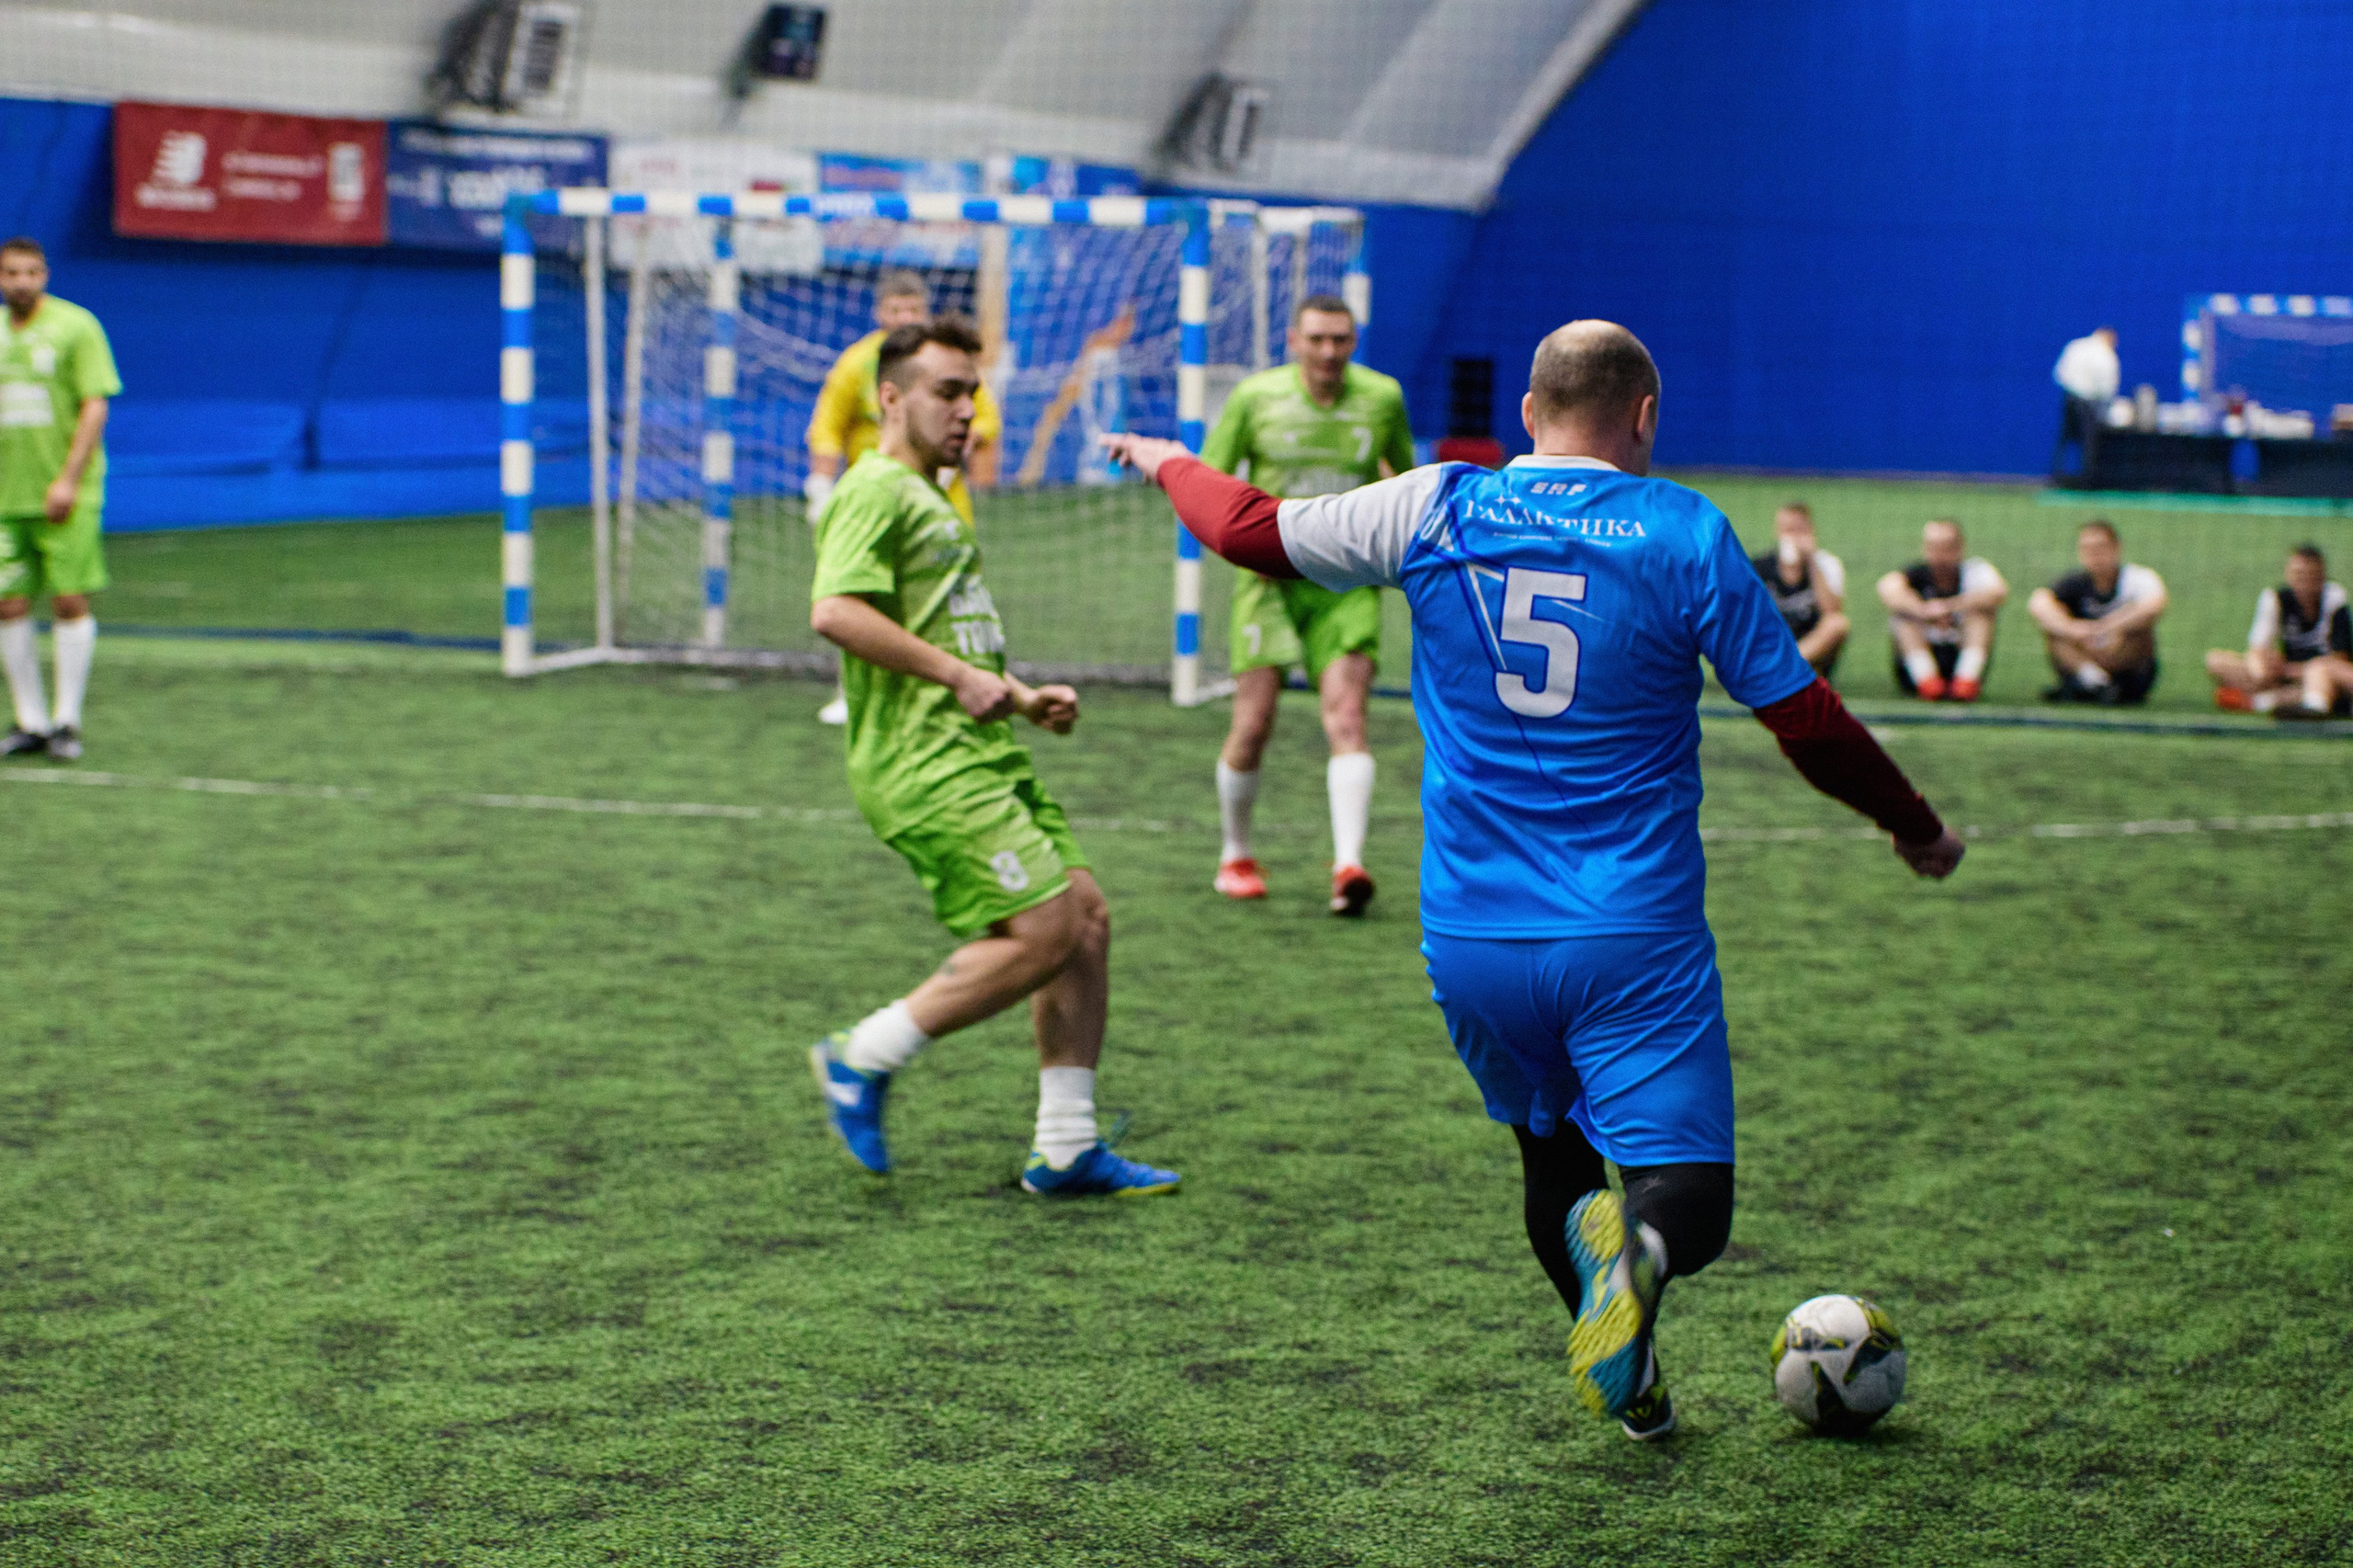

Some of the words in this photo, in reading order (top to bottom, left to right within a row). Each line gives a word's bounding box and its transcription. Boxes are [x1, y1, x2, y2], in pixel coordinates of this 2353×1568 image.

[1463, 498, 1646, 538] ГАЛАКТИКА
[1495, 566, 1587, 719] 5
[989, 849, 1029, 892] 8
